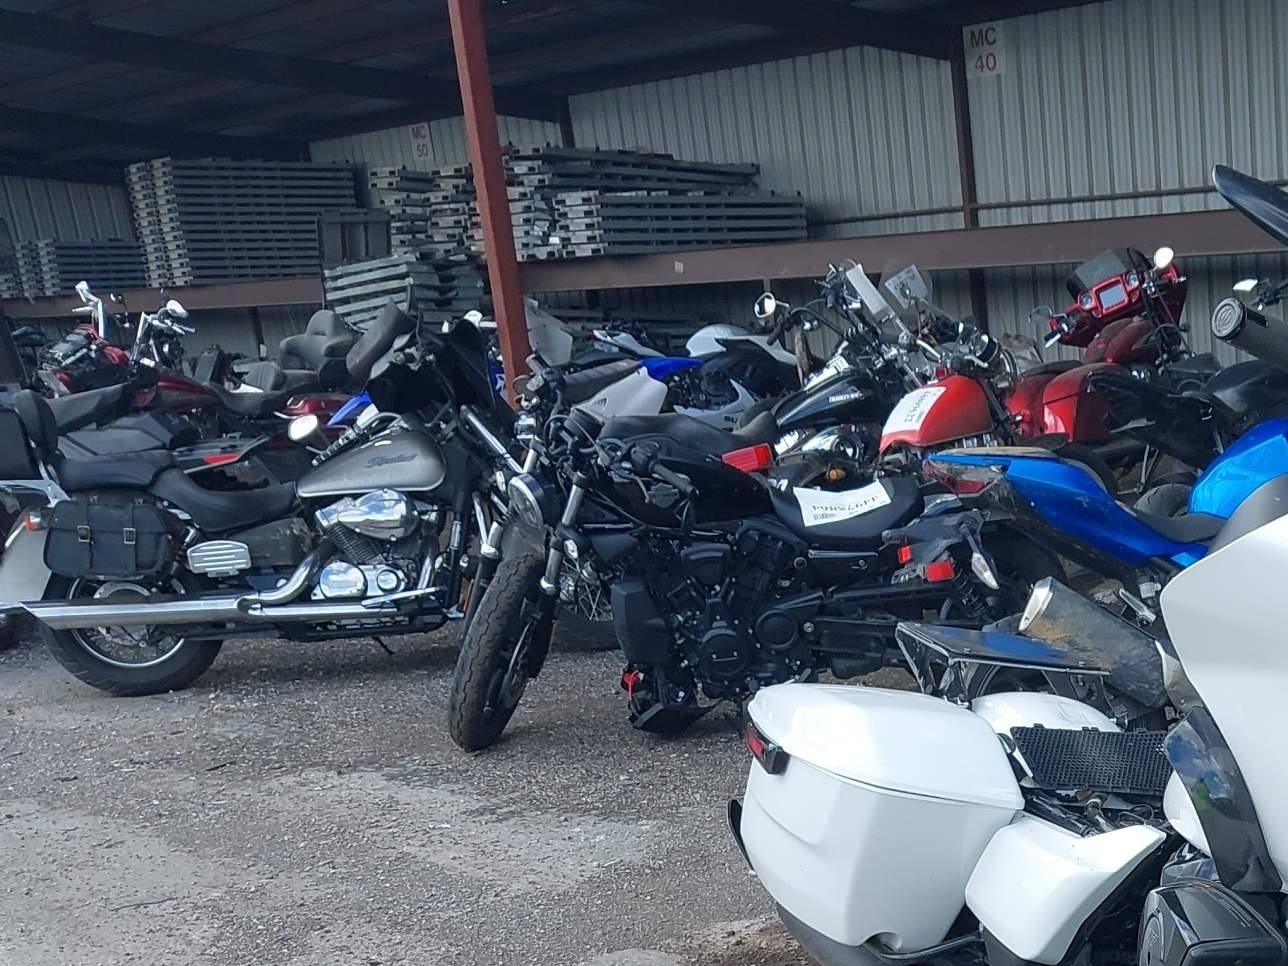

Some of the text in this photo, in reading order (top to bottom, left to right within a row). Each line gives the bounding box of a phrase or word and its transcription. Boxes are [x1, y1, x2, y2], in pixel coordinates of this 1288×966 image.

[970, 27, 997, 48] MC
[976, 53, 997, 72] 40
[411, 125, 426, 139] MC
